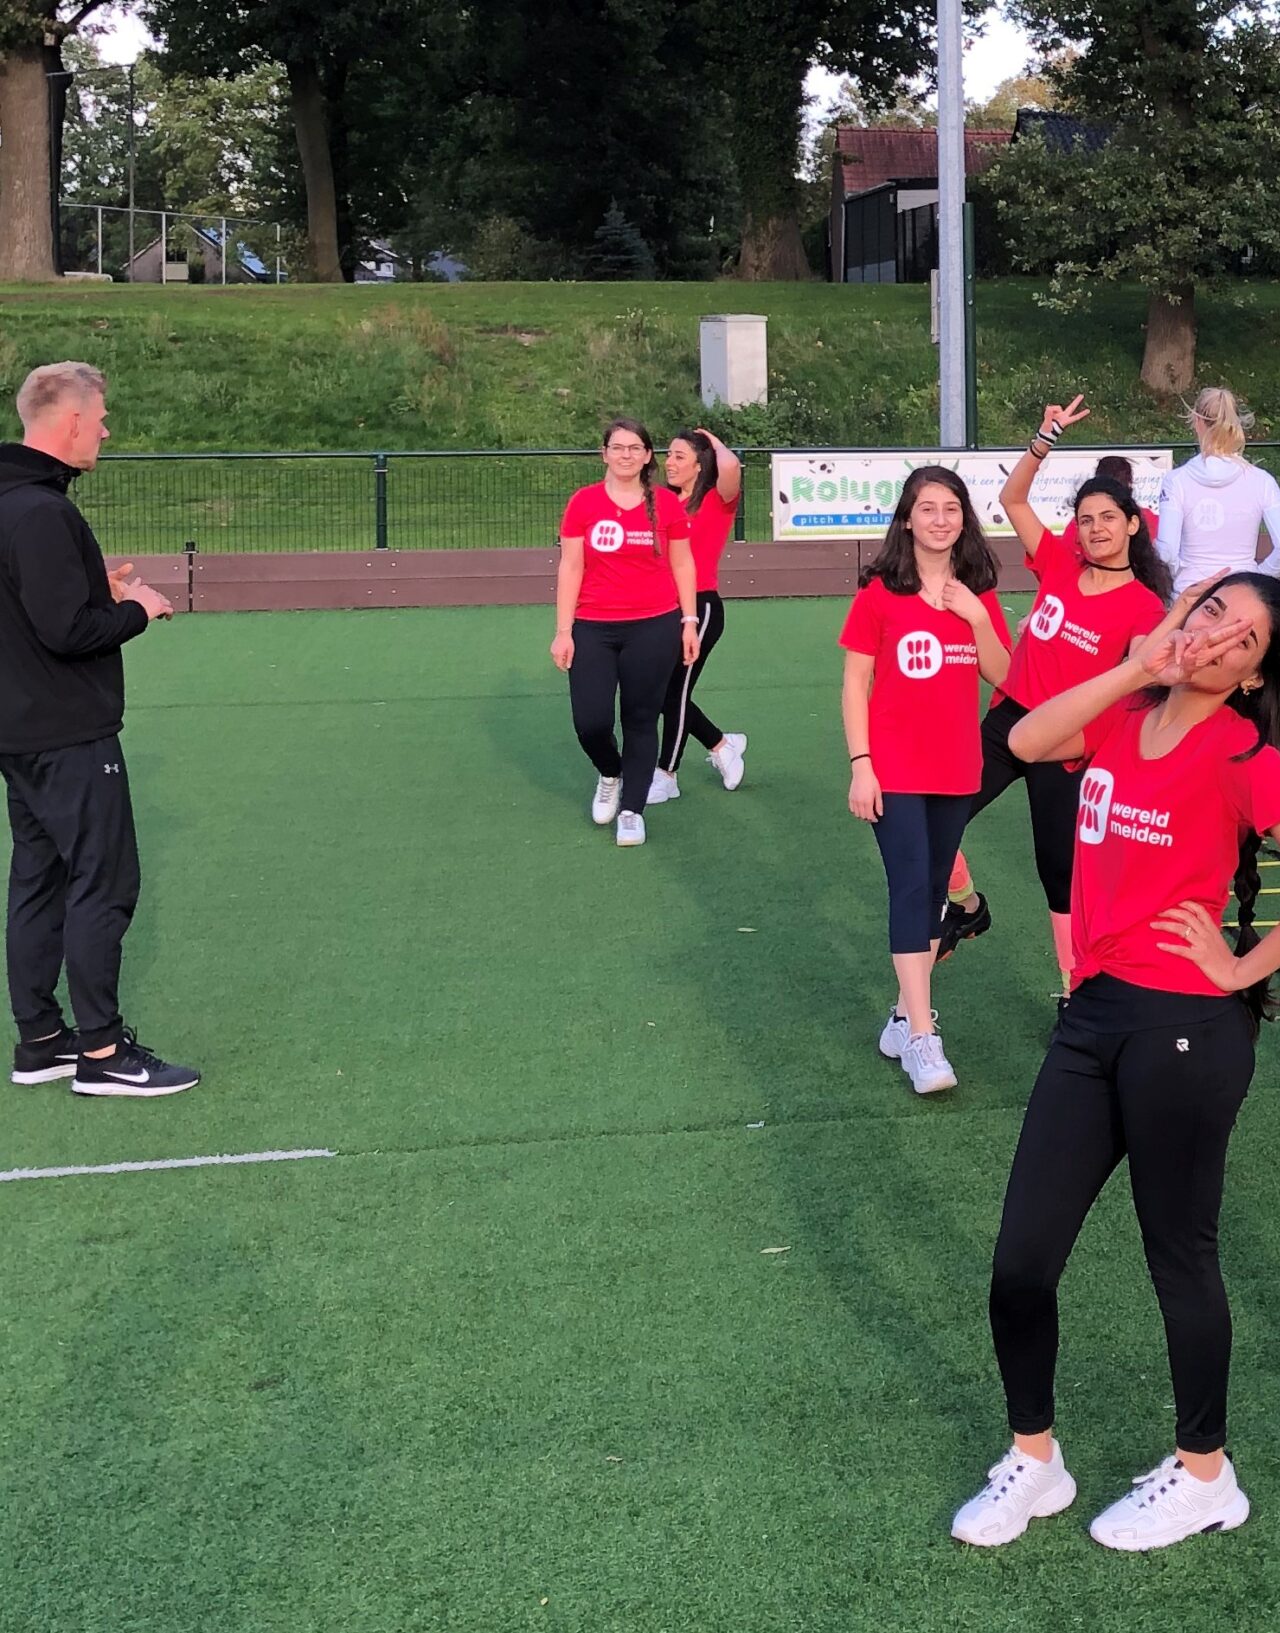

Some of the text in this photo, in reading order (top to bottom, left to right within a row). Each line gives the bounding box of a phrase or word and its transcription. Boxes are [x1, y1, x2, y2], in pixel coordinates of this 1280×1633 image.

[800, 514, 834, 525] pitch
[841, 514, 849, 524] &
[1060, 630, 1099, 656] meiden
[1064, 620, 1101, 644] wereld
[1111, 801, 1170, 828] wereld
[1110, 820, 1174, 848] meiden
